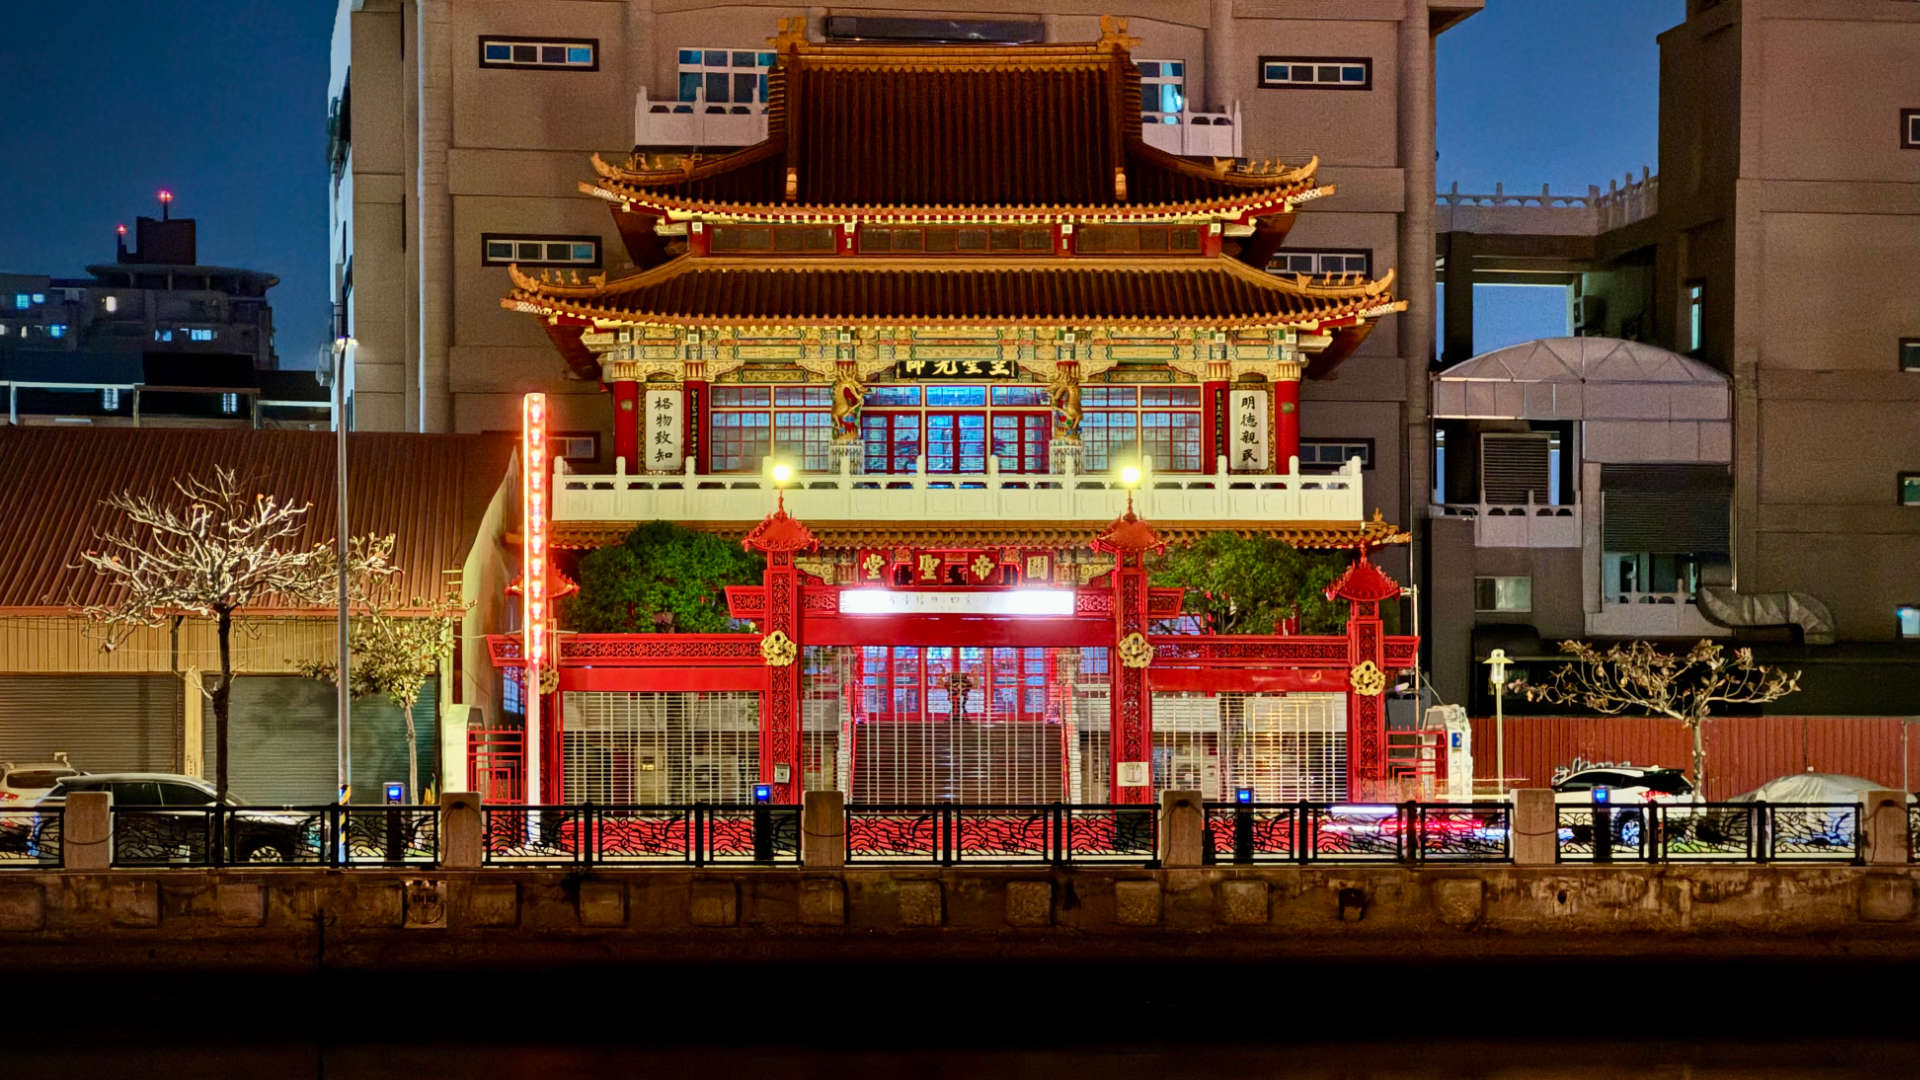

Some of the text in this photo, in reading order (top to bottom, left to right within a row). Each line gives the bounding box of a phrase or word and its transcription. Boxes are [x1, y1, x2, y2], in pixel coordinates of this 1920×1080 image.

[654, 396, 673, 462] 格物致知
[1240, 396, 1259, 463] 明德親民
